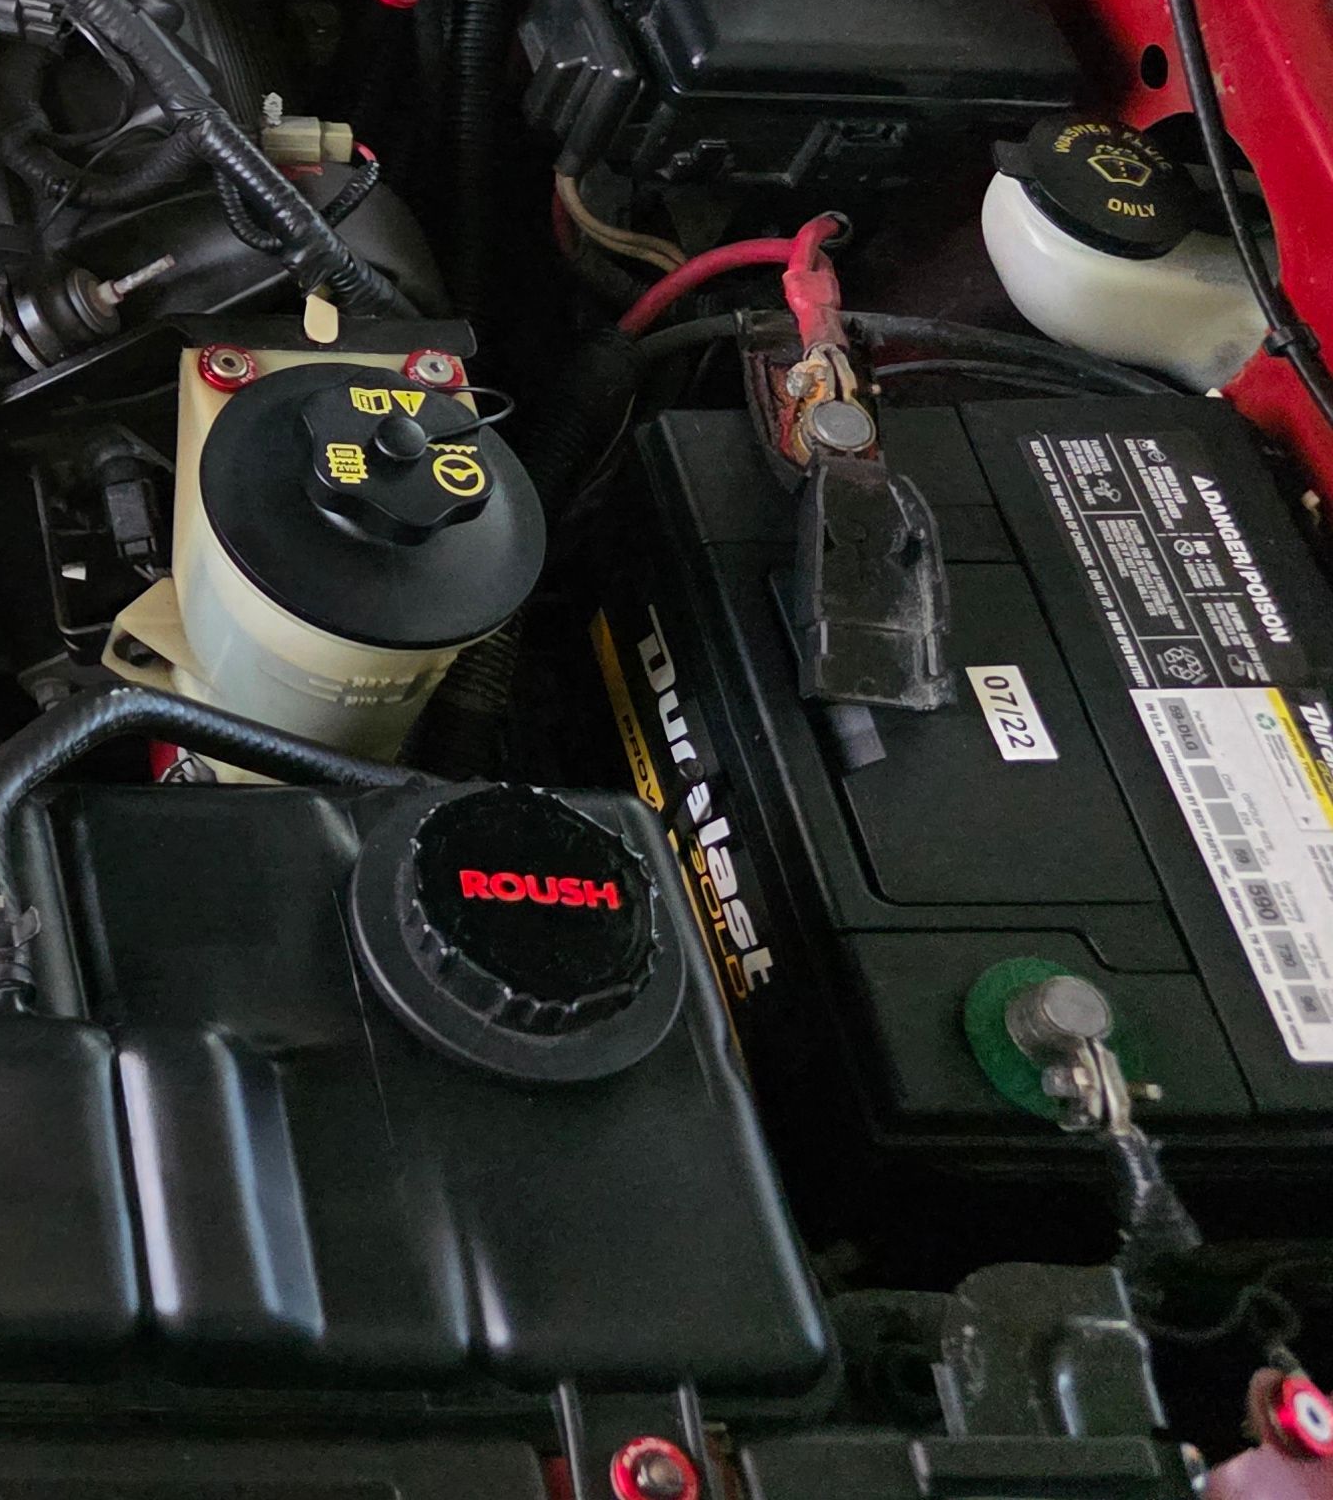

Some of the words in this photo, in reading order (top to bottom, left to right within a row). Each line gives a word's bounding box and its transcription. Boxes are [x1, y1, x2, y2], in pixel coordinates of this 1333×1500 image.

[1053, 123, 1111, 154] WASHER
[1107, 198, 1155, 218] ONLY
[1191, 540, 1211, 554] NO
[1200, 489, 1292, 643] DANGER/POISON
[983, 675, 1036, 748] 07/22
[622, 713, 663, 812] PROV
[637, 604, 774, 992] Duralast
[1160, 741, 1192, 793] DISTRIBUTED
[1191, 809, 1210, 831] BEST
[459, 869, 621, 910] ROUSH
[688, 832, 748, 1000] GOLD
[1245, 884, 1280, 920] 590
